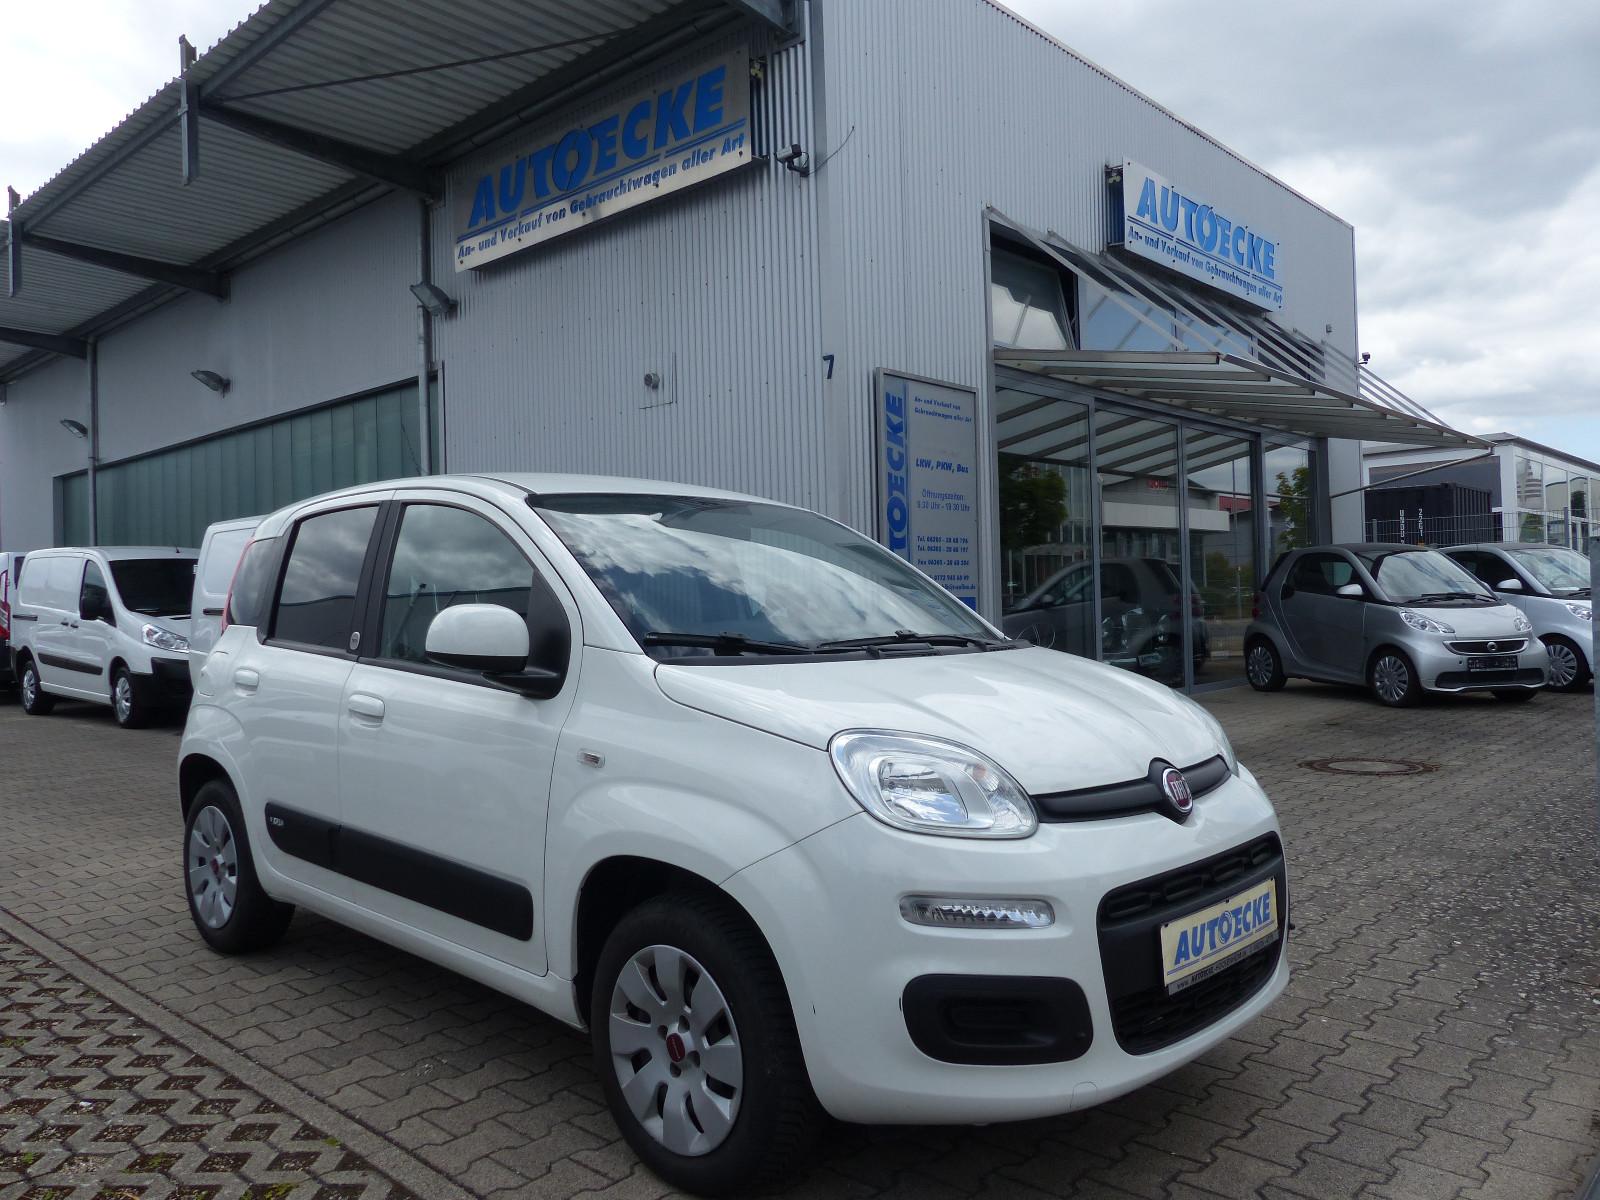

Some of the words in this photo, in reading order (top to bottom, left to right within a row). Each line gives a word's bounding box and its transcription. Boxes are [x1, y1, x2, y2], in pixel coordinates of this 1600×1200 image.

[468, 64, 726, 229] AUTOECKE
[457, 245, 476, 259] An-
[478, 235, 498, 252] und
[500, 212, 544, 243] Verkauf
[546, 208, 567, 225] von
[569, 161, 677, 214] Gebrauchtwagen
[681, 149, 717, 171] aller
[1136, 176, 1275, 280] AUTOECKE
[1145, 236, 1159, 250] und
[1160, 240, 1190, 263] Verkauf
[1191, 255, 1204, 270] von
[1205, 260, 1257, 294] Gebrauchtwagen
[1258, 286, 1272, 299] aller
[1273, 290, 1283, 304] Art
[822, 354, 835, 380] 7
[916, 457, 934, 471] LKW,
[936, 461, 955, 474] PKW,
[956, 463, 969, 474] Bus
[1173, 890, 1271, 966] AUTOECKE
